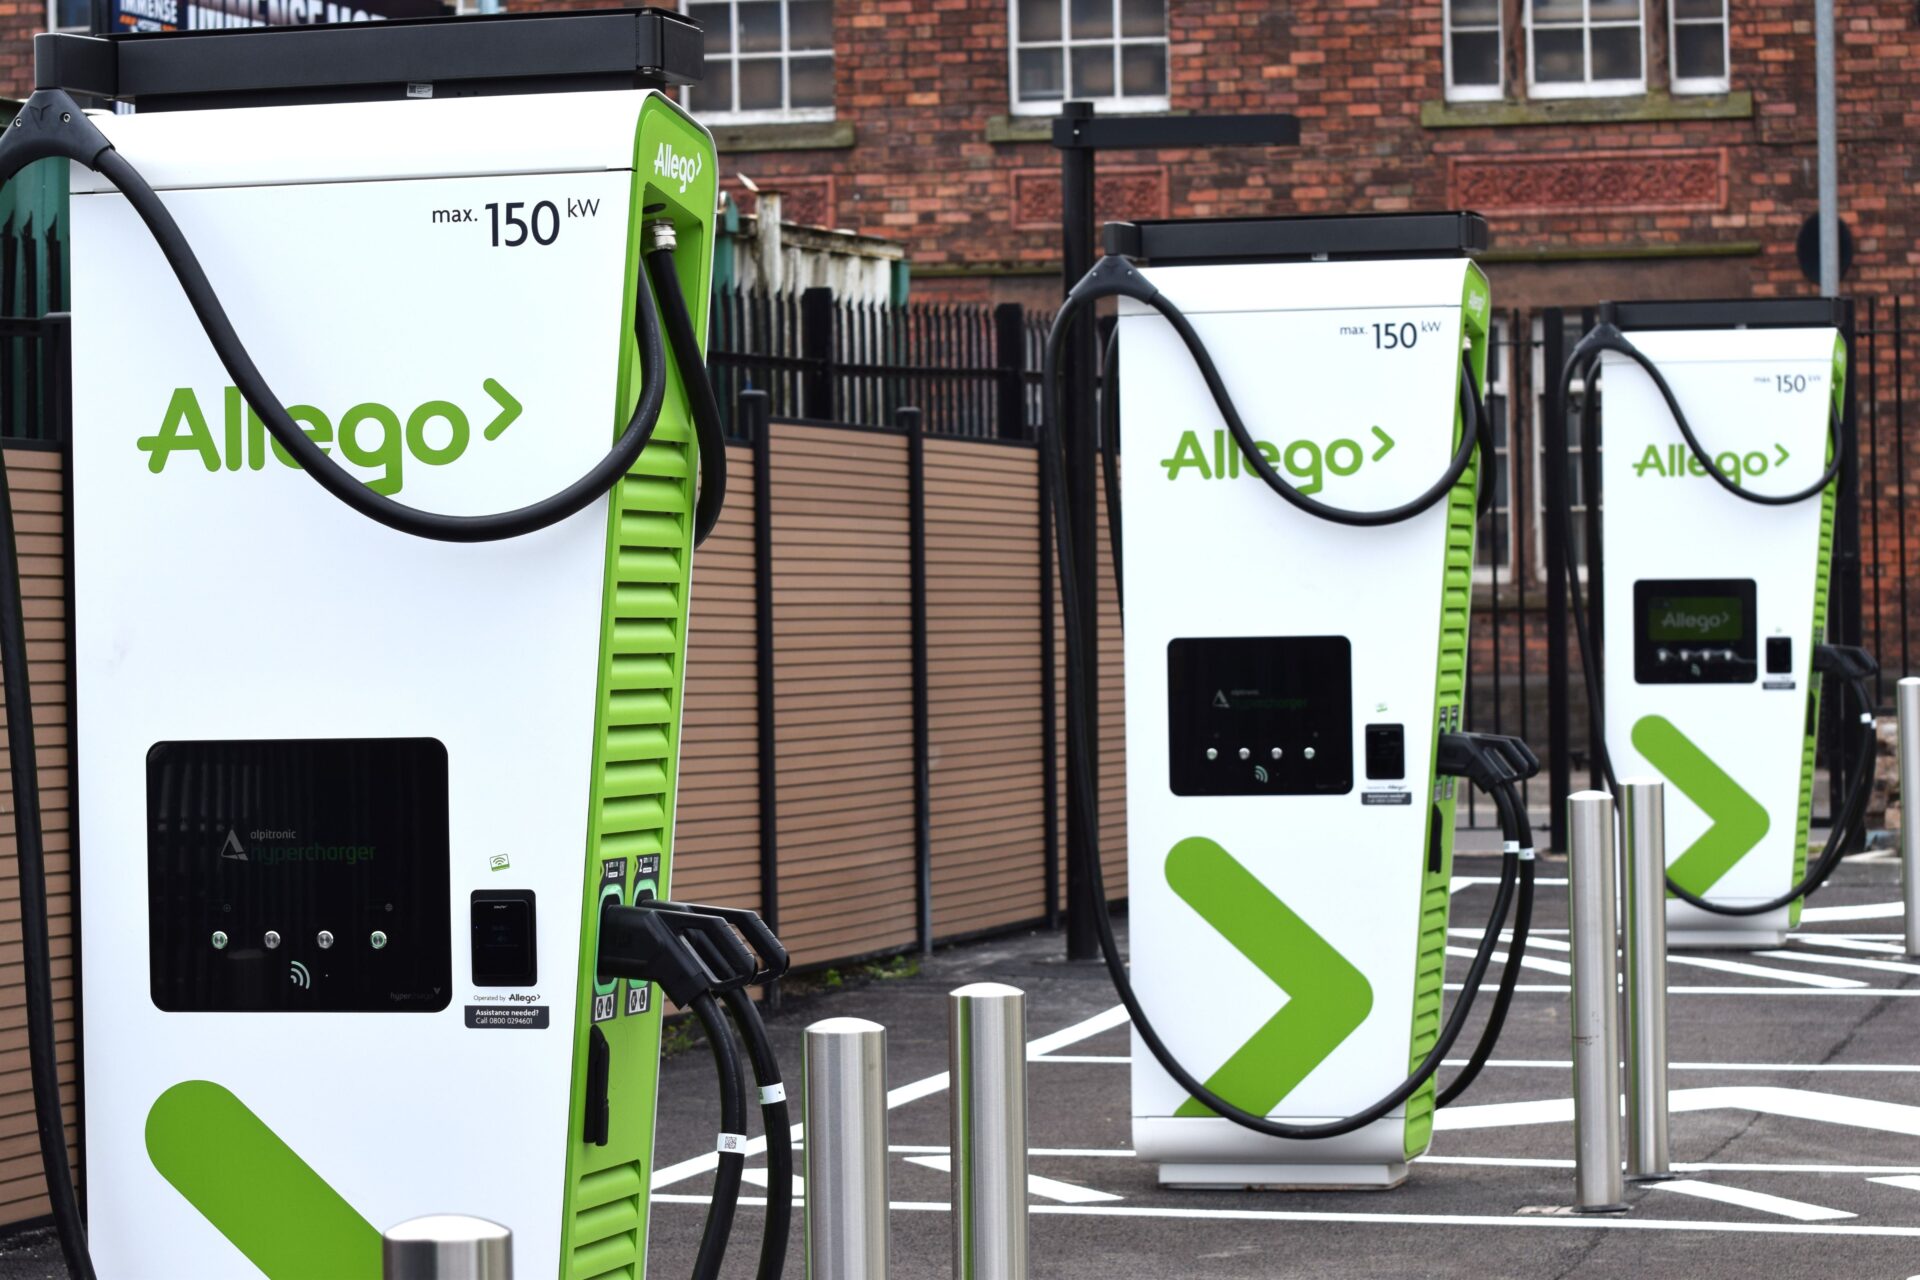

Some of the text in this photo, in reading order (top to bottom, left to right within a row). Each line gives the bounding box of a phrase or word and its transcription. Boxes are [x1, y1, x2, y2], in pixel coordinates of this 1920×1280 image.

[655, 143, 694, 193] Allego
[432, 198, 600, 247] max. 150 kW
[1340, 320, 1441, 349] max. 150 kW
[1776, 374, 1806, 393] 150
[137, 386, 470, 497] Allego
[1160, 429, 1364, 496] Allego
[1632, 444, 1769, 488] Allego
[1661, 612, 1721, 632] Allego
[250, 829, 296, 841] alpitronic
[473, 993, 537, 1004] Operated by Allego
